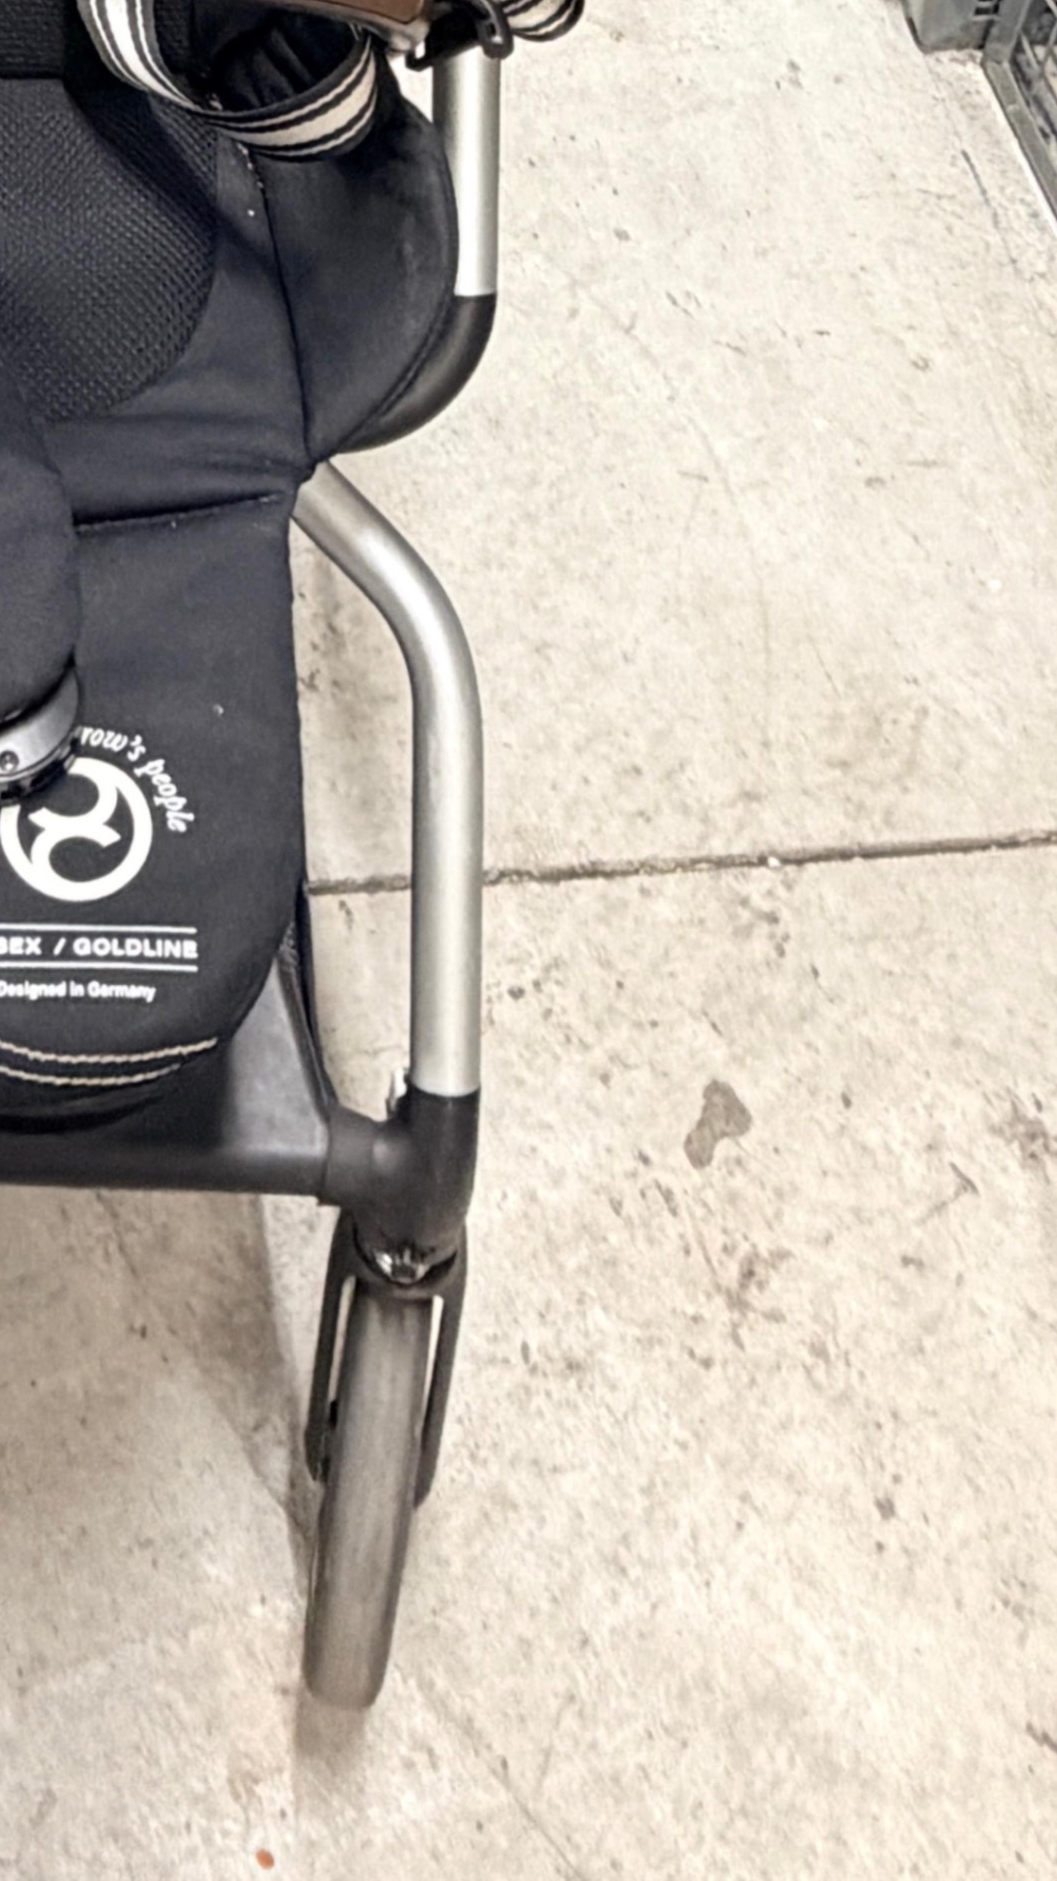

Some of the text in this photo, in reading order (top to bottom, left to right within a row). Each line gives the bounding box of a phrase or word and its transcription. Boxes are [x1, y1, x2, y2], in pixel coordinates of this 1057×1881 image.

[133, 758, 196, 834] people
[72, 937, 199, 960] GOLDLINE
[69, 979, 86, 999] in
[87, 980, 157, 1004] Germany
